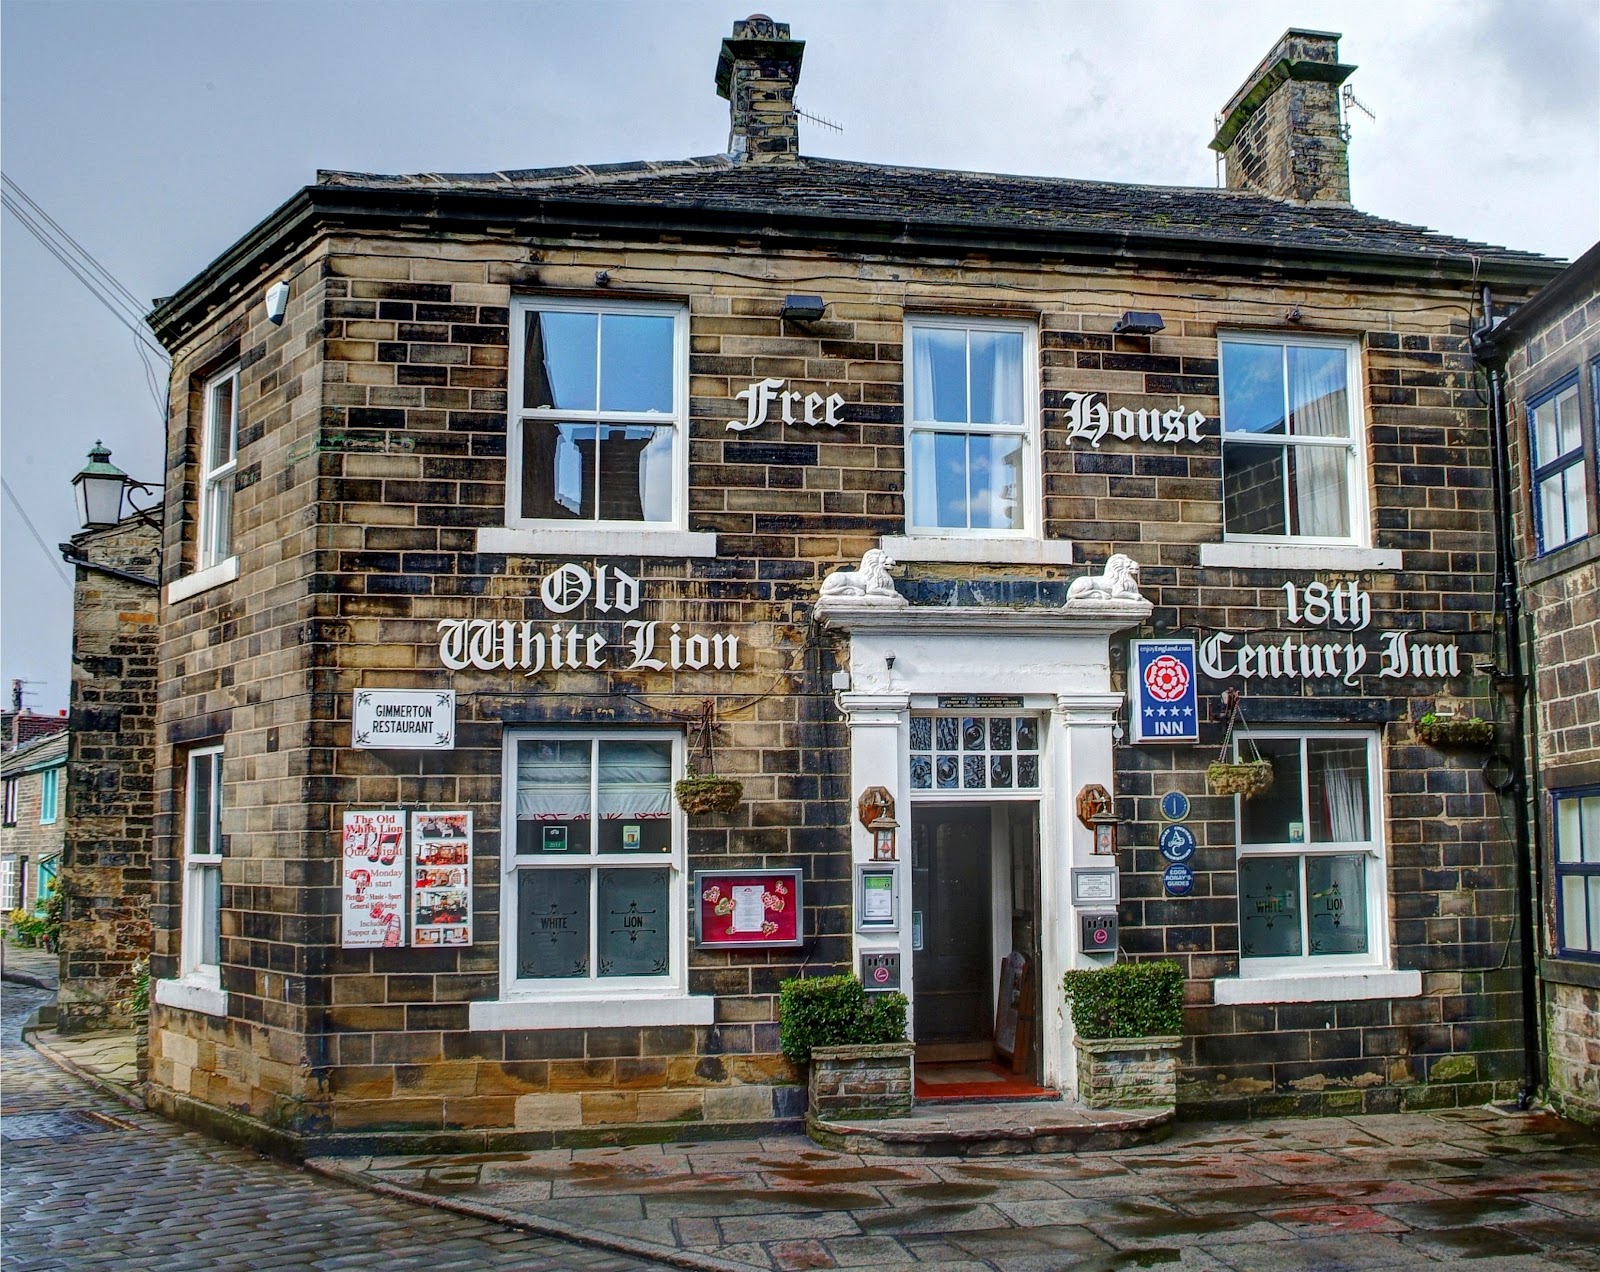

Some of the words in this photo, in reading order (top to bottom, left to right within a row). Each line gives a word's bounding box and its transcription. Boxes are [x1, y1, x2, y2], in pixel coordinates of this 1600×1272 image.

[725, 378, 846, 432] Free
[1064, 391, 1207, 448] House
[540, 562, 641, 615] Old
[1281, 580, 1372, 632] 18th
[436, 619, 607, 677] White
[624, 620, 741, 672] Lion
[1140, 645, 1192, 653] enjoyEngland.com
[1198, 631, 1366, 686] Century
[1379, 632, 1461, 679] Inn
[375, 704, 432, 718] GIMMERTON
[372, 720, 434, 734] RESTAURANT
[1154, 721, 1183, 735] INN
[353, 814, 374, 824] The
[376, 814, 395, 824] Old
[346, 824, 377, 833] White
[380, 824, 403, 833] Lion
[344, 846, 370, 859] Quiz
[370, 870, 403, 878] Monday
[1256, 900, 1283, 912] WHITE
[541, 917, 568, 929] WHITE
[623, 916, 643, 928] LION
